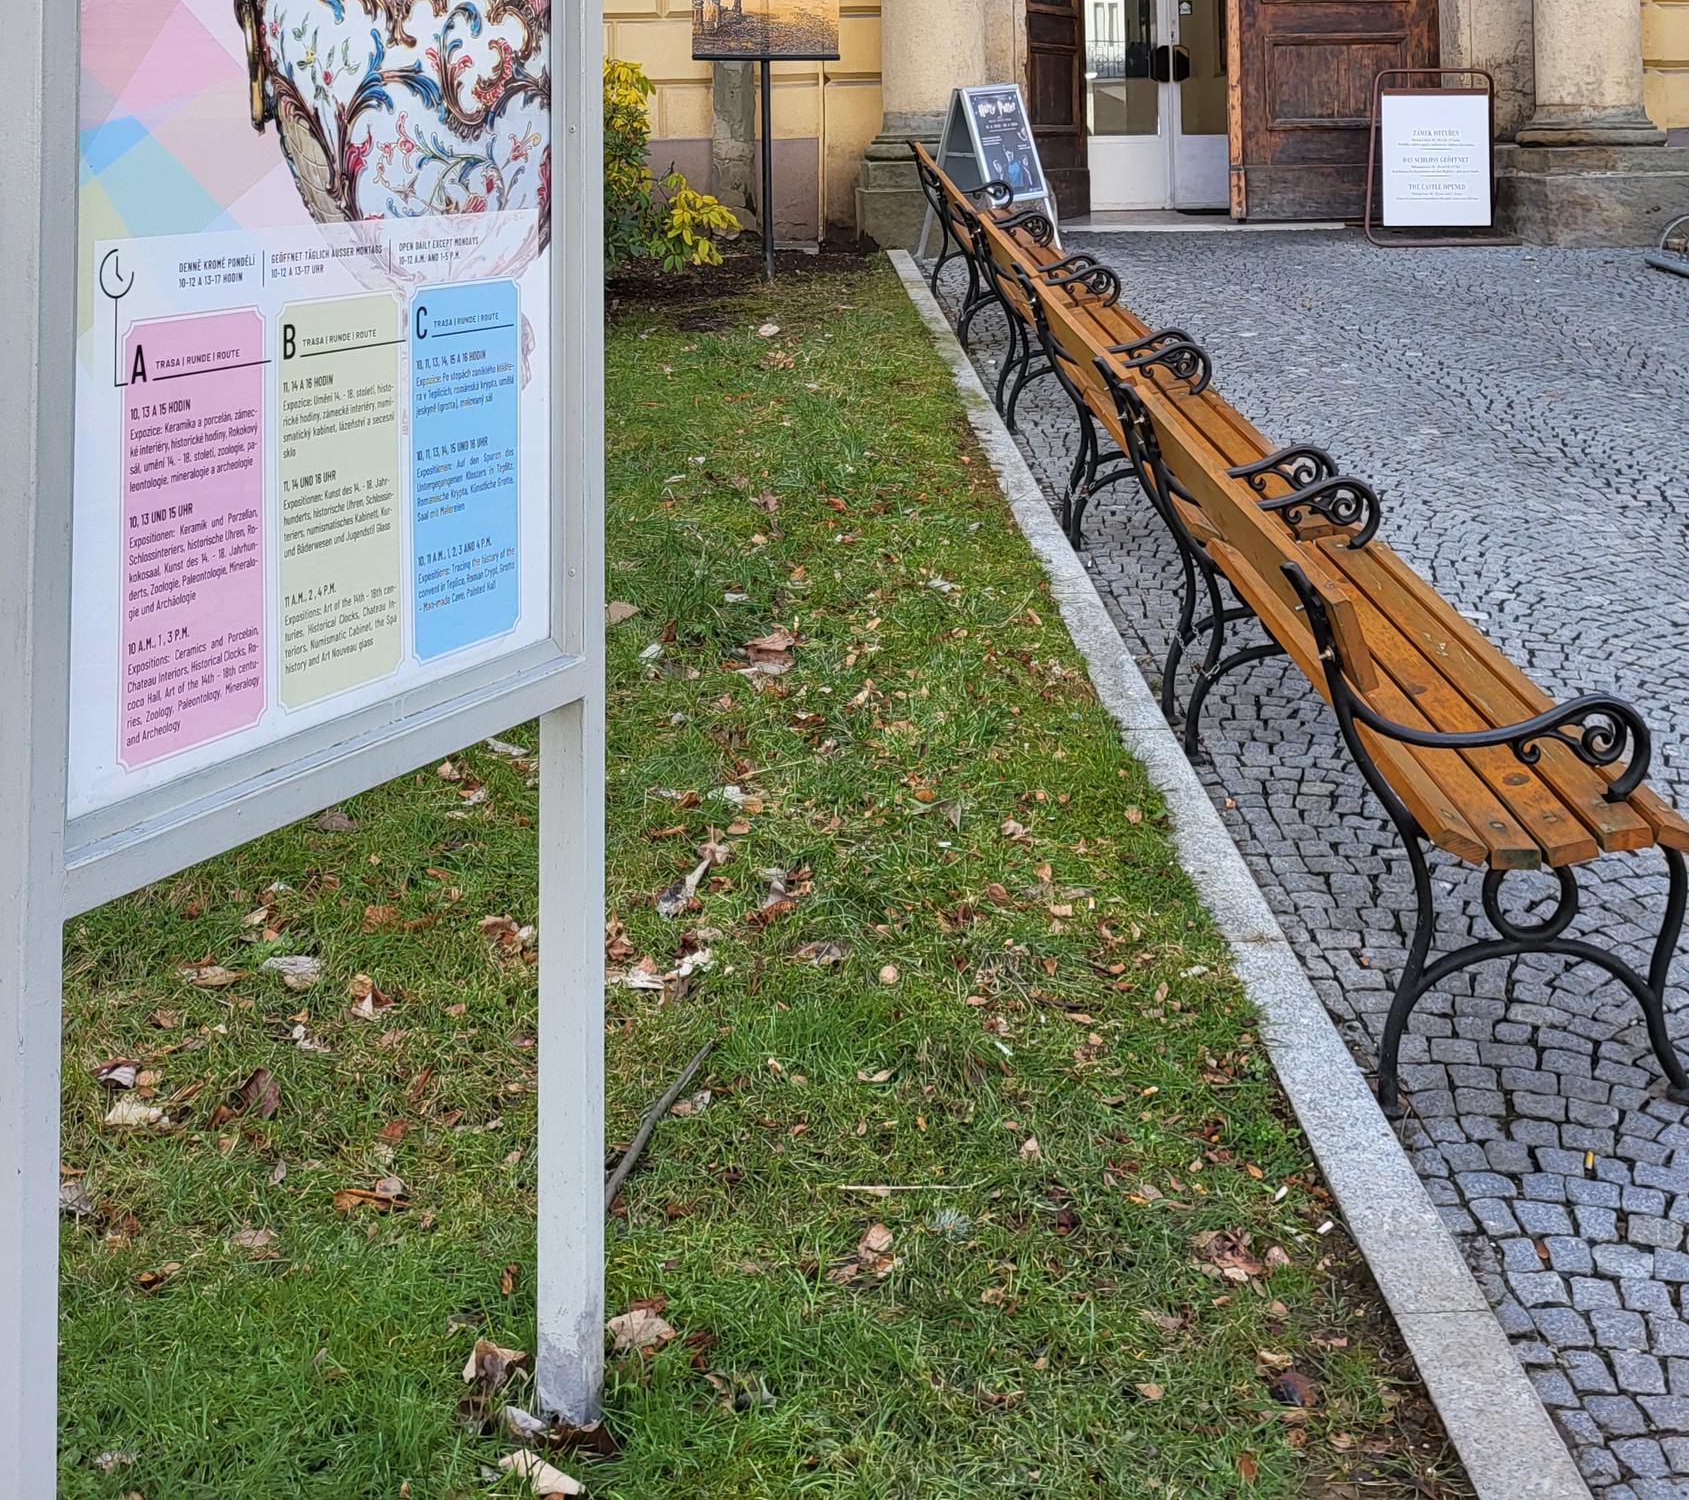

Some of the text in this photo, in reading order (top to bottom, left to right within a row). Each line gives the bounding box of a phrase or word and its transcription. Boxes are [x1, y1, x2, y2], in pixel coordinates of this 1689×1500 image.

[399, 237, 478, 251] OPEN DAILY EXCEPT MONDAYS
[179, 254, 255, 272] DENNĚ KROMĚ PONDĚLÍ
[272, 252, 303, 263] GEÖFFNET
[305, 250, 329, 260] TÄGLICH
[332, 247, 354, 257] AUSSER
[179, 272, 243, 288] 10-12 A 13-17 HODIN
[272, 264, 324, 278] 10-12 A 13-17 UHR
[416, 306, 427, 339] C
[434, 312, 499, 328] TRASA RUNDE ROUTE
[283, 324, 295, 360] B
[302, 329, 376, 347] TRASA RUNDE ROUTE
[131, 344, 147, 384] A
[156, 349, 240, 369] TRASA RUNDE ROUTE
[314, 374, 333, 387] HODIN
[131, 399, 191, 420] 10, 13 A 15 HODIN
[130, 426, 162, 441] Expozice:
[164, 419, 196, 433] Keramika
[204, 411, 233, 429] porcelán,
[234, 408, 258, 420] zámec-
[130, 422, 258, 458] ké interiéry, historické hodiny, Rokokový
[130, 477, 168, 493] leontologie,
[171, 468, 209, 484] mineralogie
[217, 457, 253, 473] archeologie
[130, 503, 193, 529] 10, 13 UND 15 UHR
